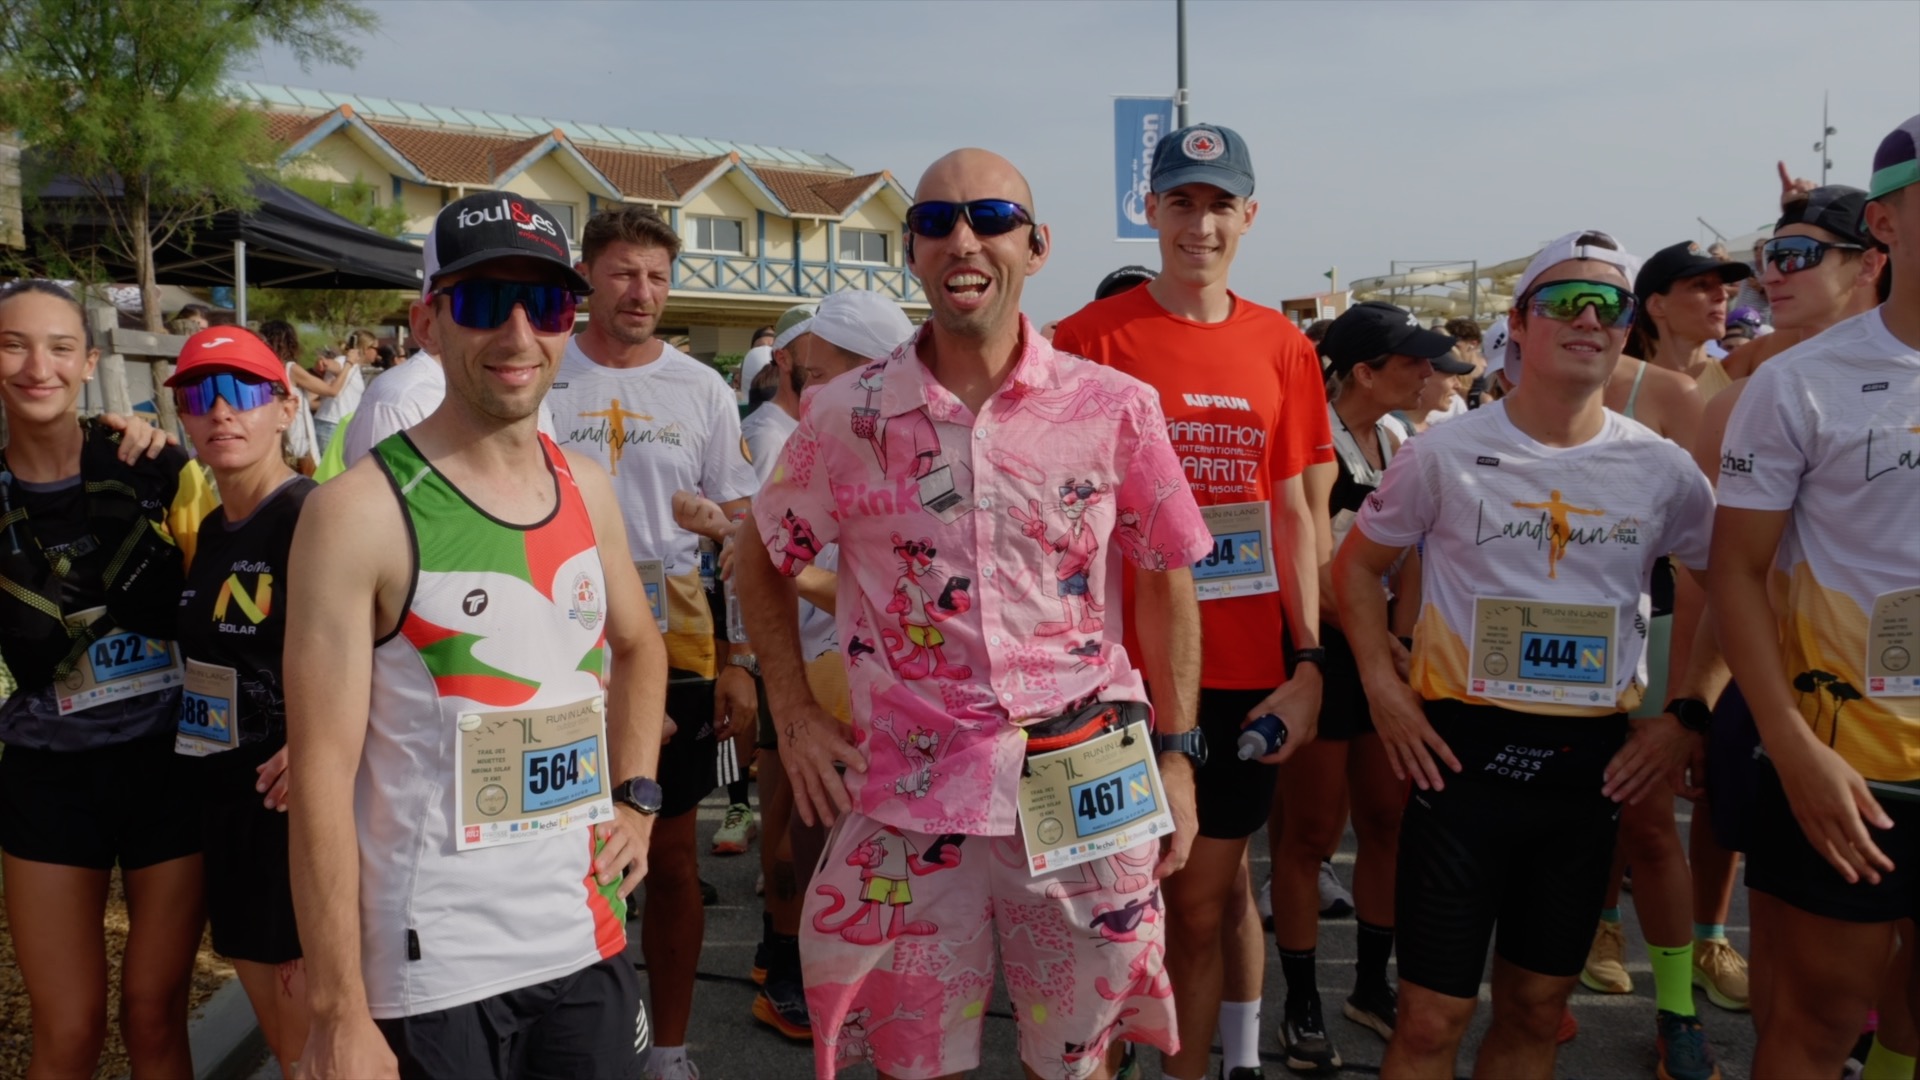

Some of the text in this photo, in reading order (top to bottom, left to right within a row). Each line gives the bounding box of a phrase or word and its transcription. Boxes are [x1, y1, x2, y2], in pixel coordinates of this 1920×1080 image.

[553, 412, 656, 453] andirun
[1181, 455, 1258, 483] ARRITZ
[835, 473, 920, 519] Pink
[1189, 482, 1206, 492] AYS
[1195, 539, 1235, 568] 94
[1542, 607, 1609, 620] RUN IN LAND
[218, 622, 257, 635] SOLAR
[95, 635, 143, 668] 422
[1524, 638, 1577, 669] 444
[546, 705, 596, 724] RUN IN LAN
[1083, 746, 1104, 760] RUN
[1104, 743, 1114, 752] IN
[1115, 733, 1138, 748] LD
[1504, 744, 1555, 758] COMP
[529, 749, 578, 795] 564
[1484, 762, 1536, 782] PORT
[1494, 752, 1542, 771] RESS
[1077, 777, 1124, 820] 467
